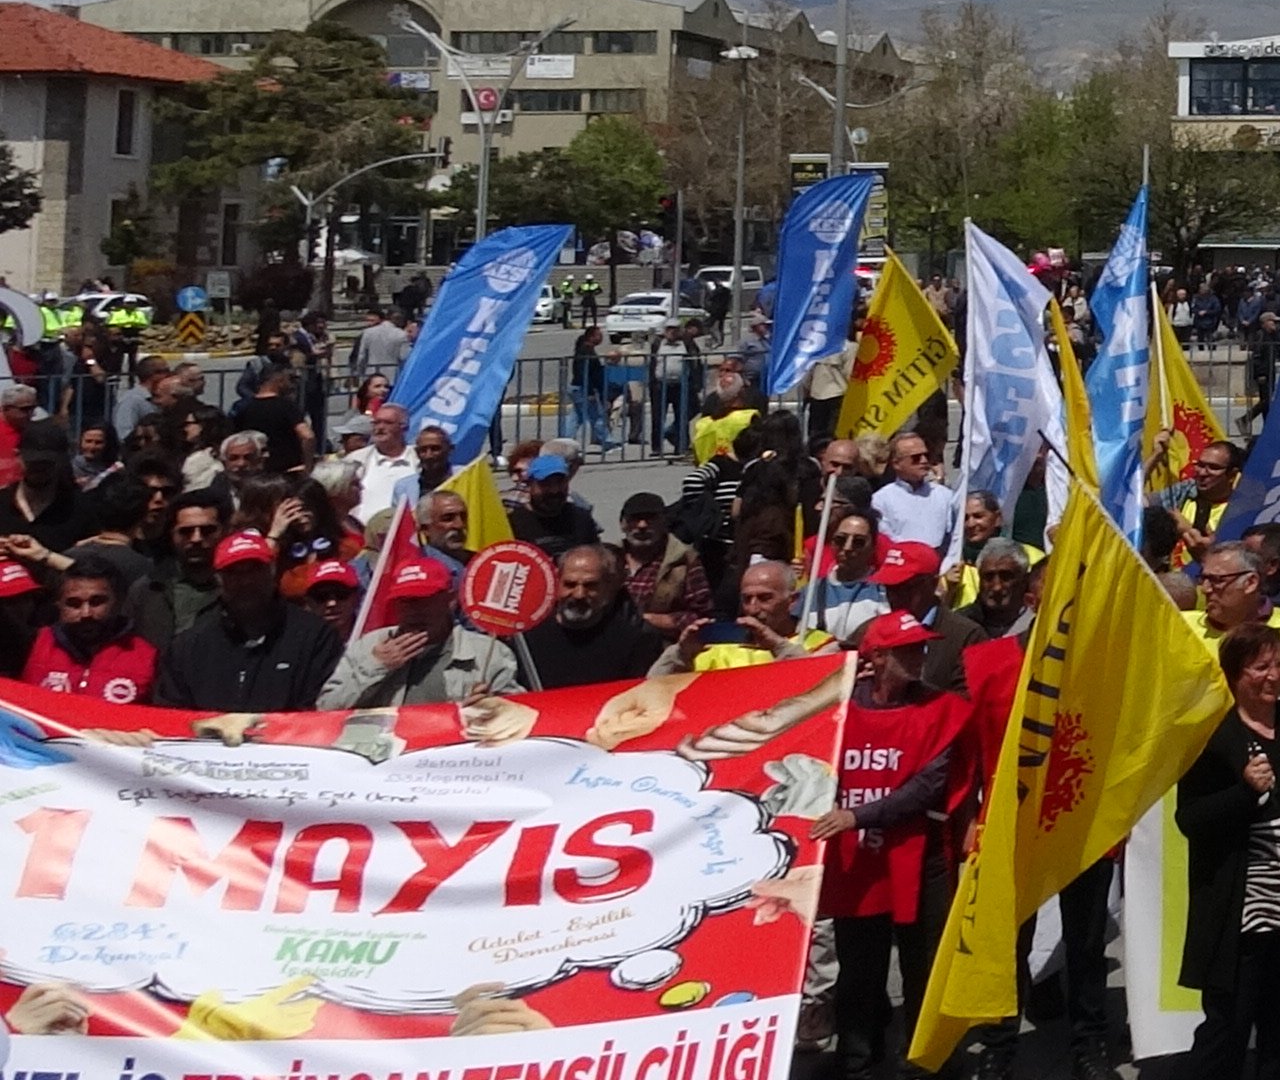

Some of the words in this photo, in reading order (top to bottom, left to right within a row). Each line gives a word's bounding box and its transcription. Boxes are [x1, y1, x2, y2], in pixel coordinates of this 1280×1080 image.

[14, 806, 92, 901] 1
[124, 809, 655, 917] MAYIS
[274, 936, 402, 965] KAMU
[467, 928, 544, 953] Adalet
[493, 928, 618, 965] Demokrasi
